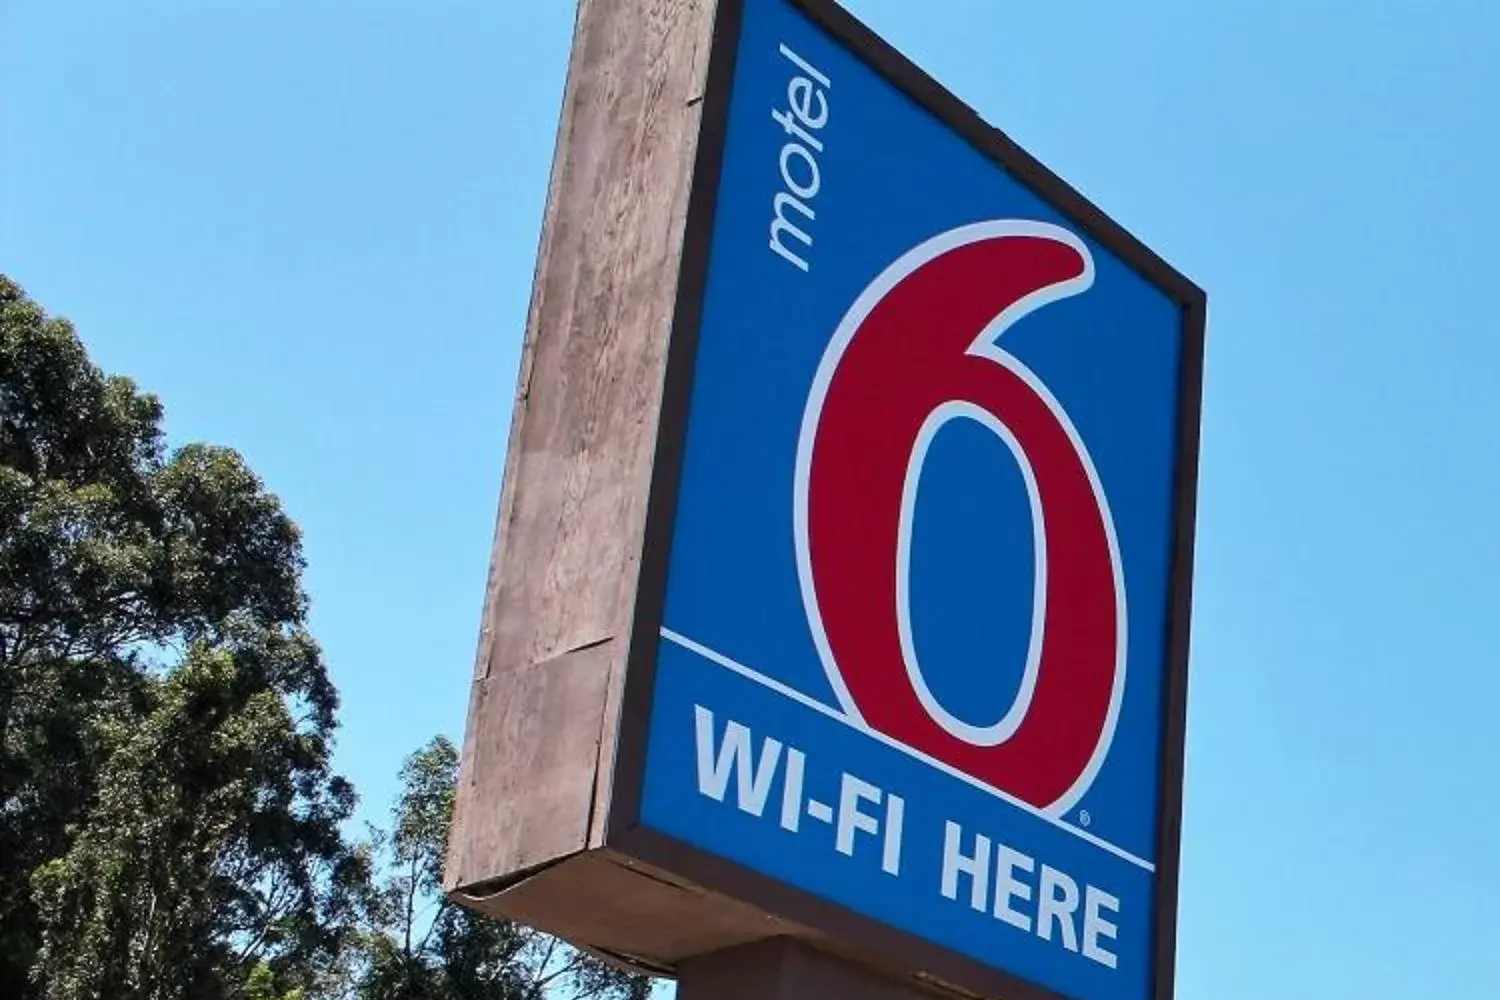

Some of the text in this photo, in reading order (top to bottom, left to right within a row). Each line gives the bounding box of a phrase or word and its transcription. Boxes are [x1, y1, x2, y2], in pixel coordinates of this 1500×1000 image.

[769, 43, 831, 272] motel
[793, 218, 1128, 818] 6
[694, 703, 1120, 969] WI-FI HERE
